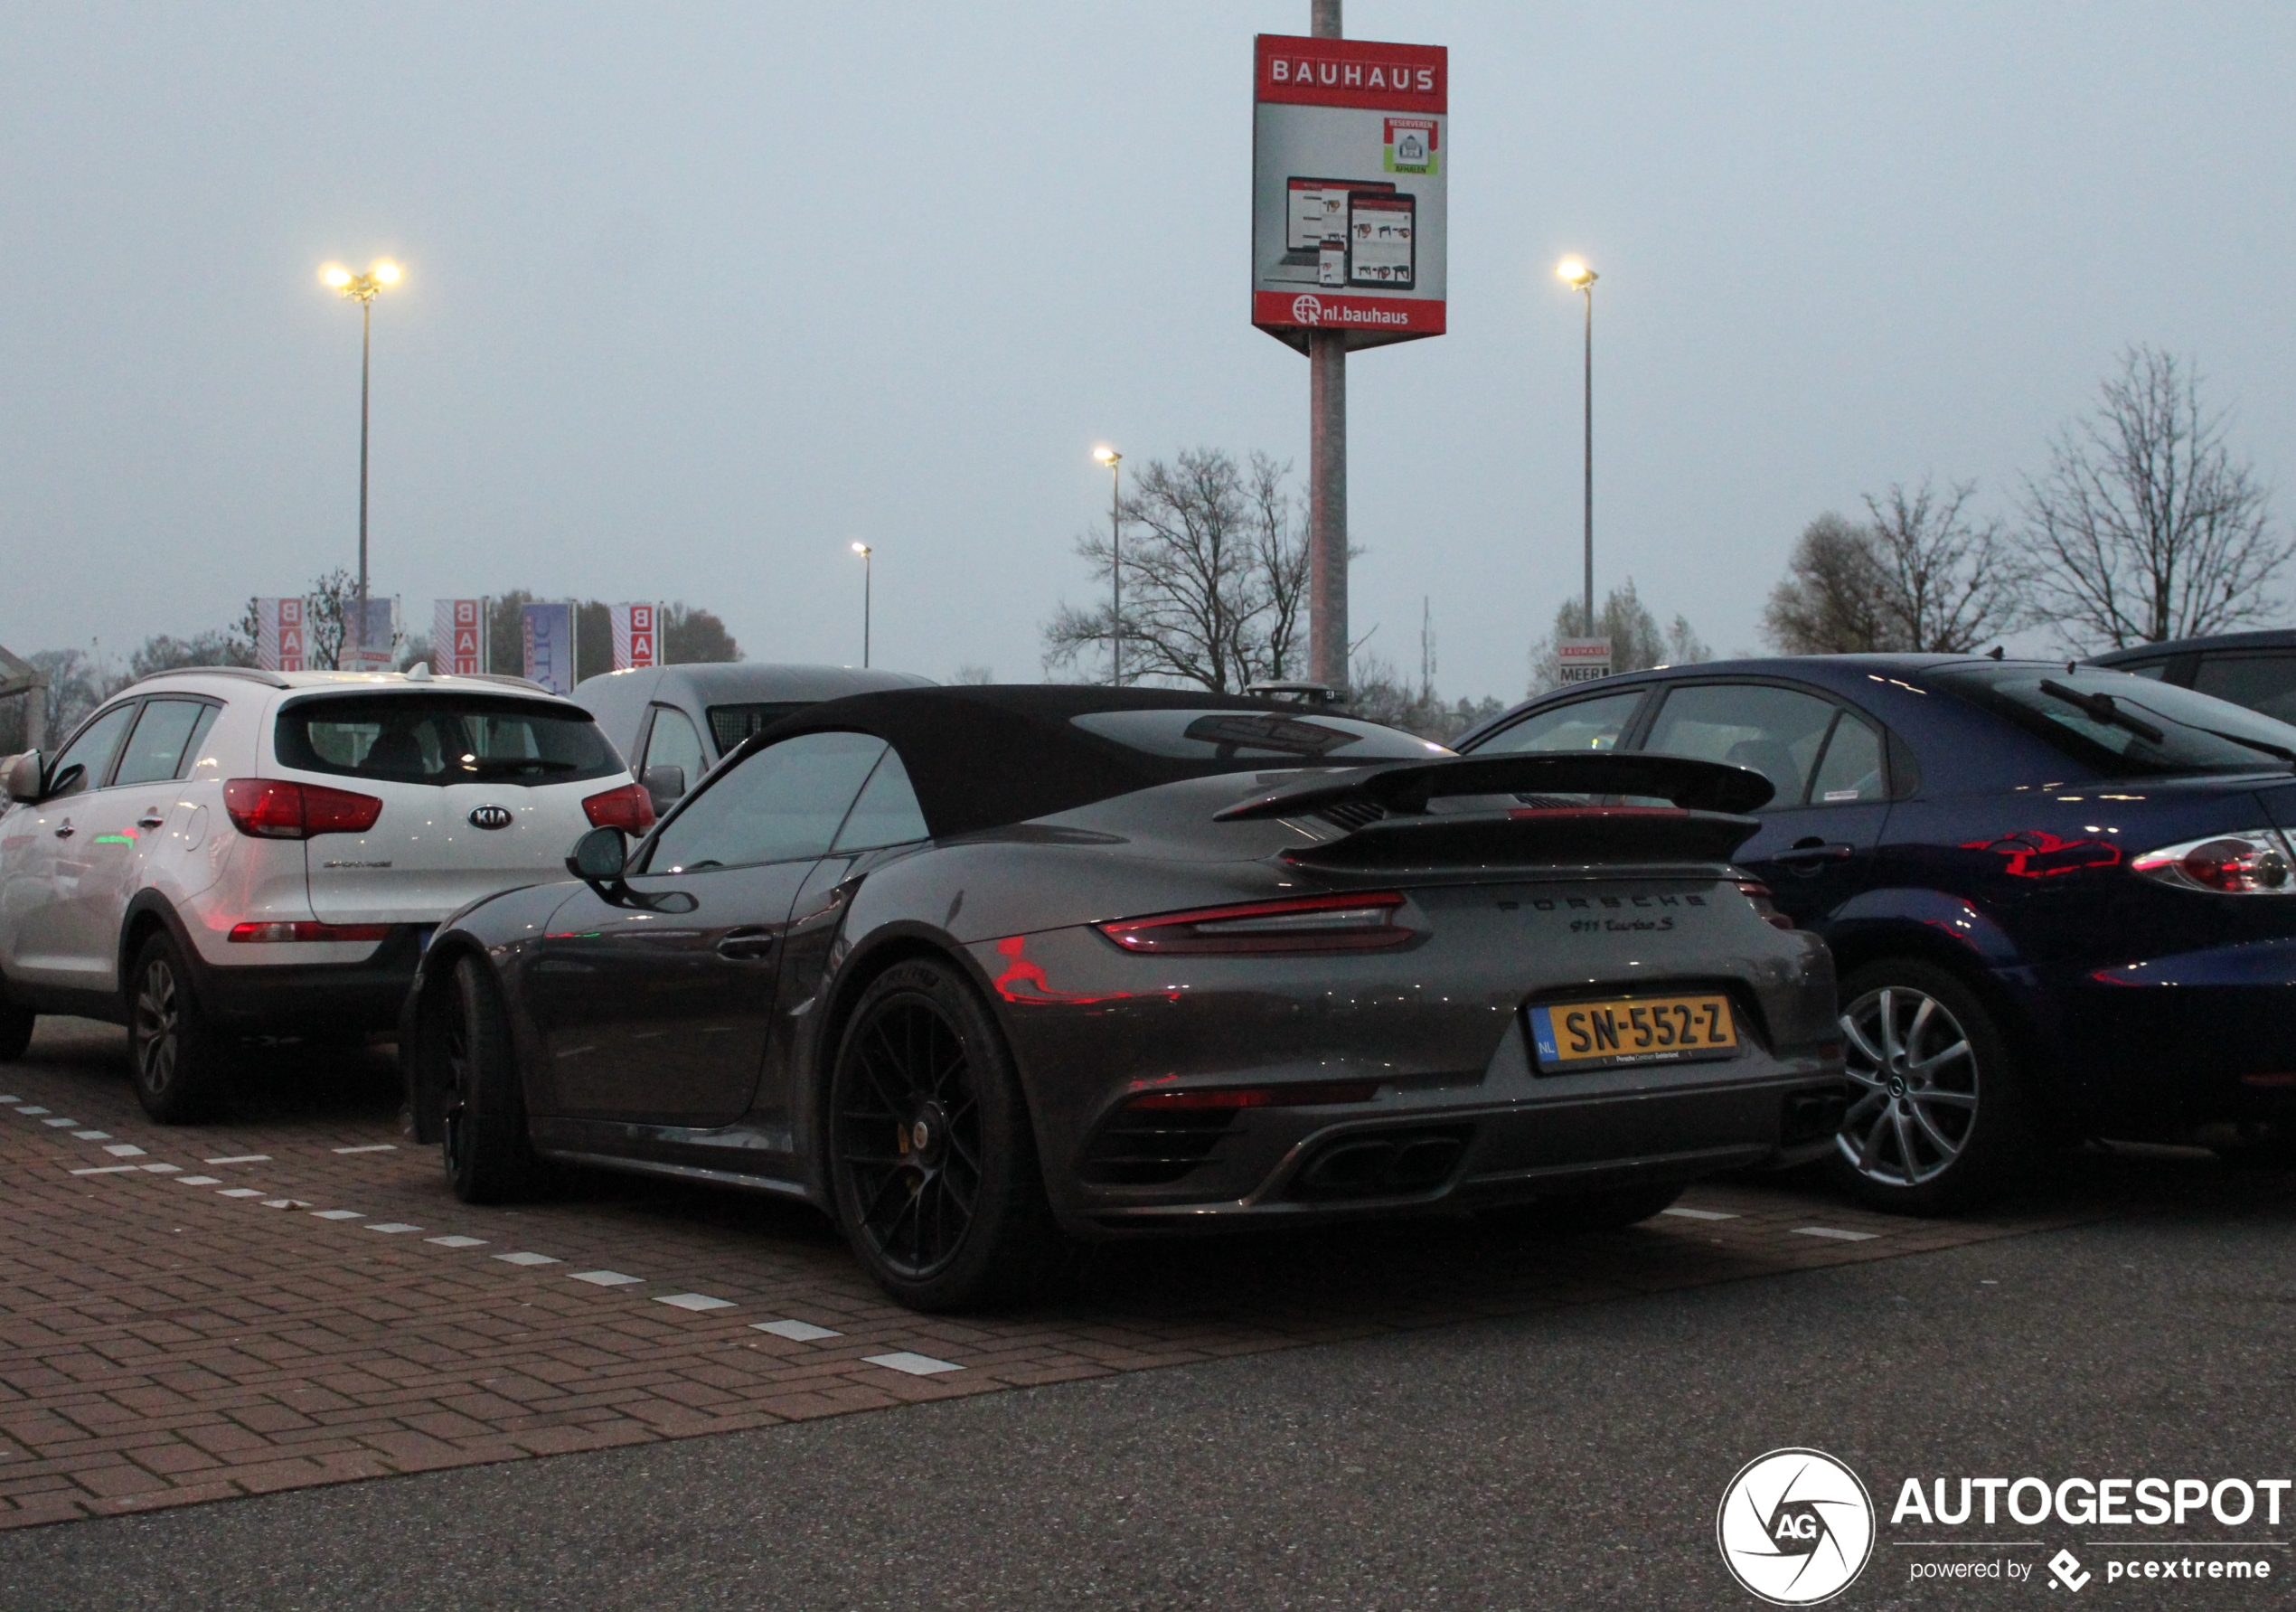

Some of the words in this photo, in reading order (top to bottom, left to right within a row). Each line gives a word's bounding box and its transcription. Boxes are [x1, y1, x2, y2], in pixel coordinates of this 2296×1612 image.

[1272, 59, 1435, 90] BAUHAUS
[1388, 118, 1434, 128] RESERVEREN
[1395, 165, 1426, 174] AFHALEN
[1322, 305, 1408, 325] nl.bauhaus
[1560, 647, 1607, 655] BAUHAUS
[1560, 667, 1600, 681] MEER
[476, 808, 508, 824] KIA
[1498, 896, 1706, 911] PORSCHE
[1570, 919, 1599, 932] 911
[1657, 917, 1673, 931] S
[1567, 1004, 1727, 1052] SN-552-Z
[1538, 1042, 1555, 1054] NL
